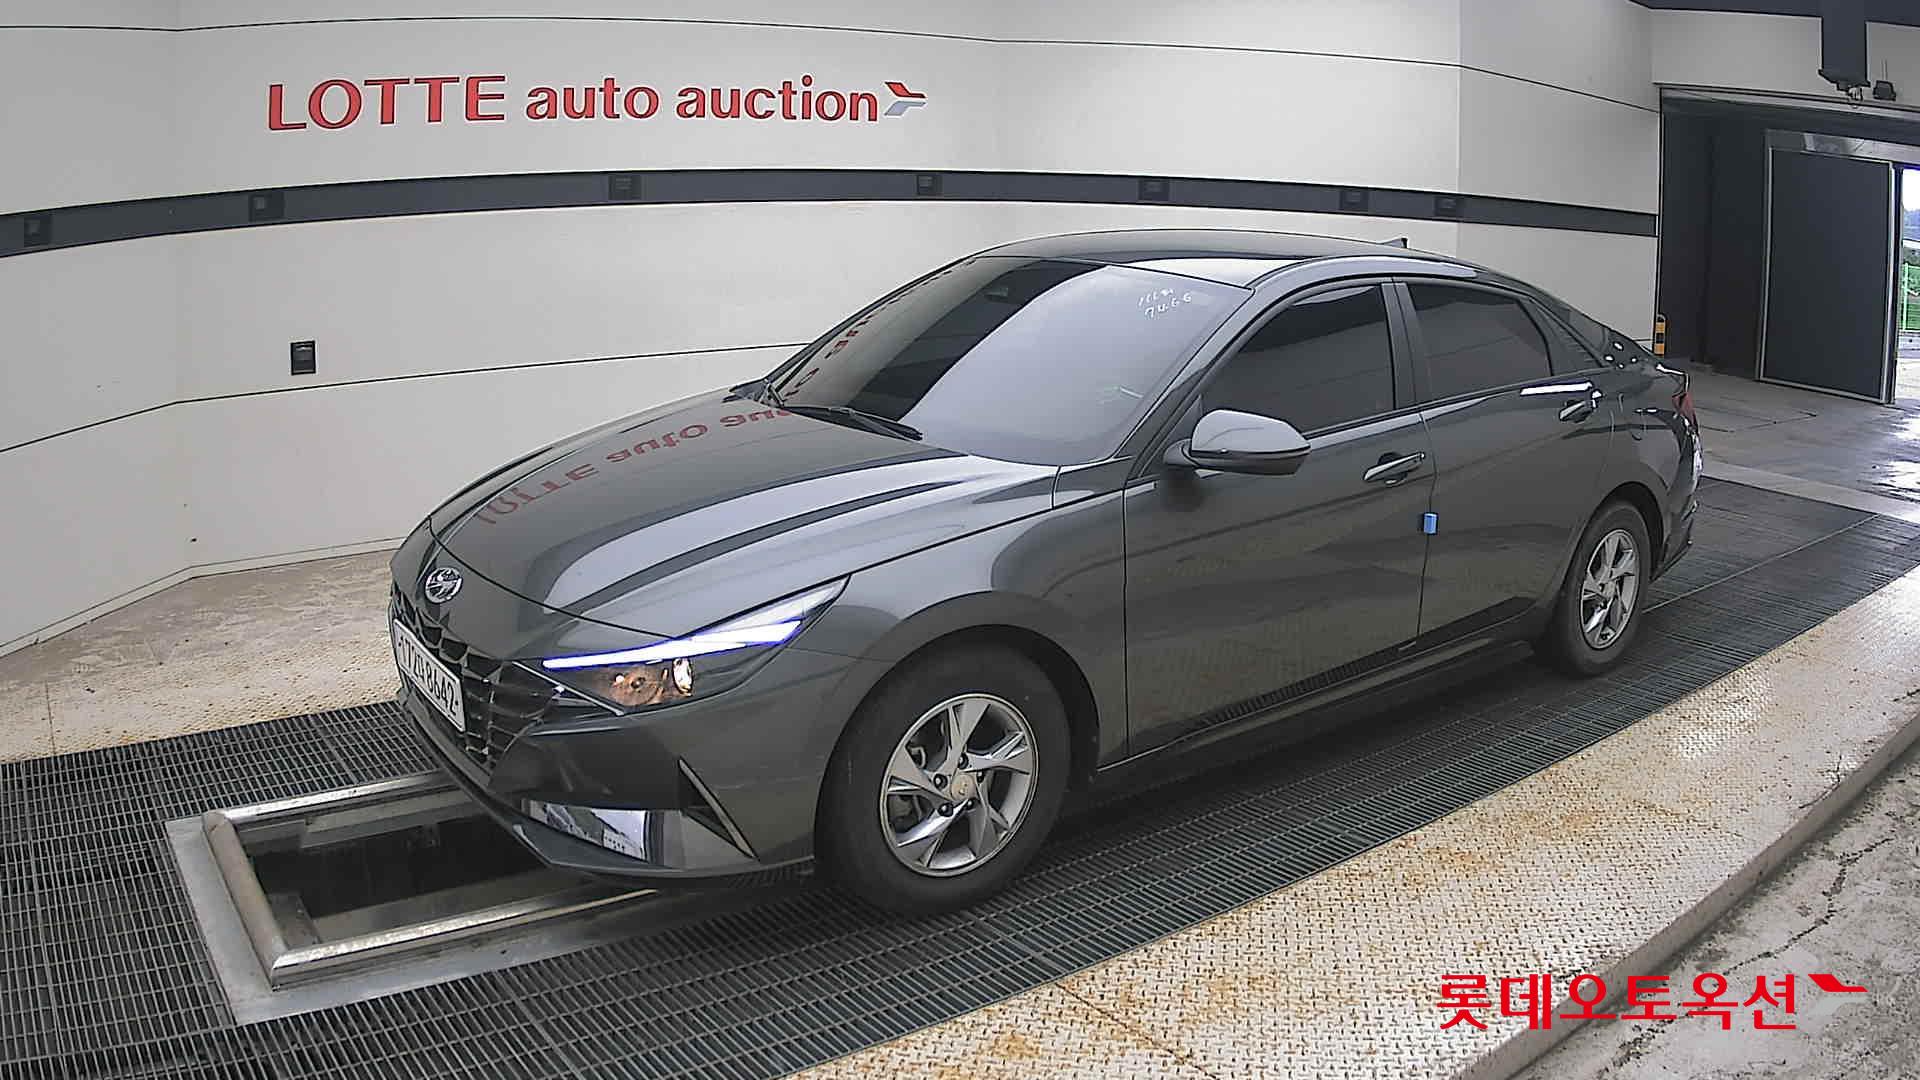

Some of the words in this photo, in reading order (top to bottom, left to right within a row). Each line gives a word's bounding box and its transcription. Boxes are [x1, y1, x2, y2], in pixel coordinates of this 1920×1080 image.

[268, 75, 506, 130] LOTTE
[525, 76, 660, 121] auto
[676, 75, 879, 122] auction
